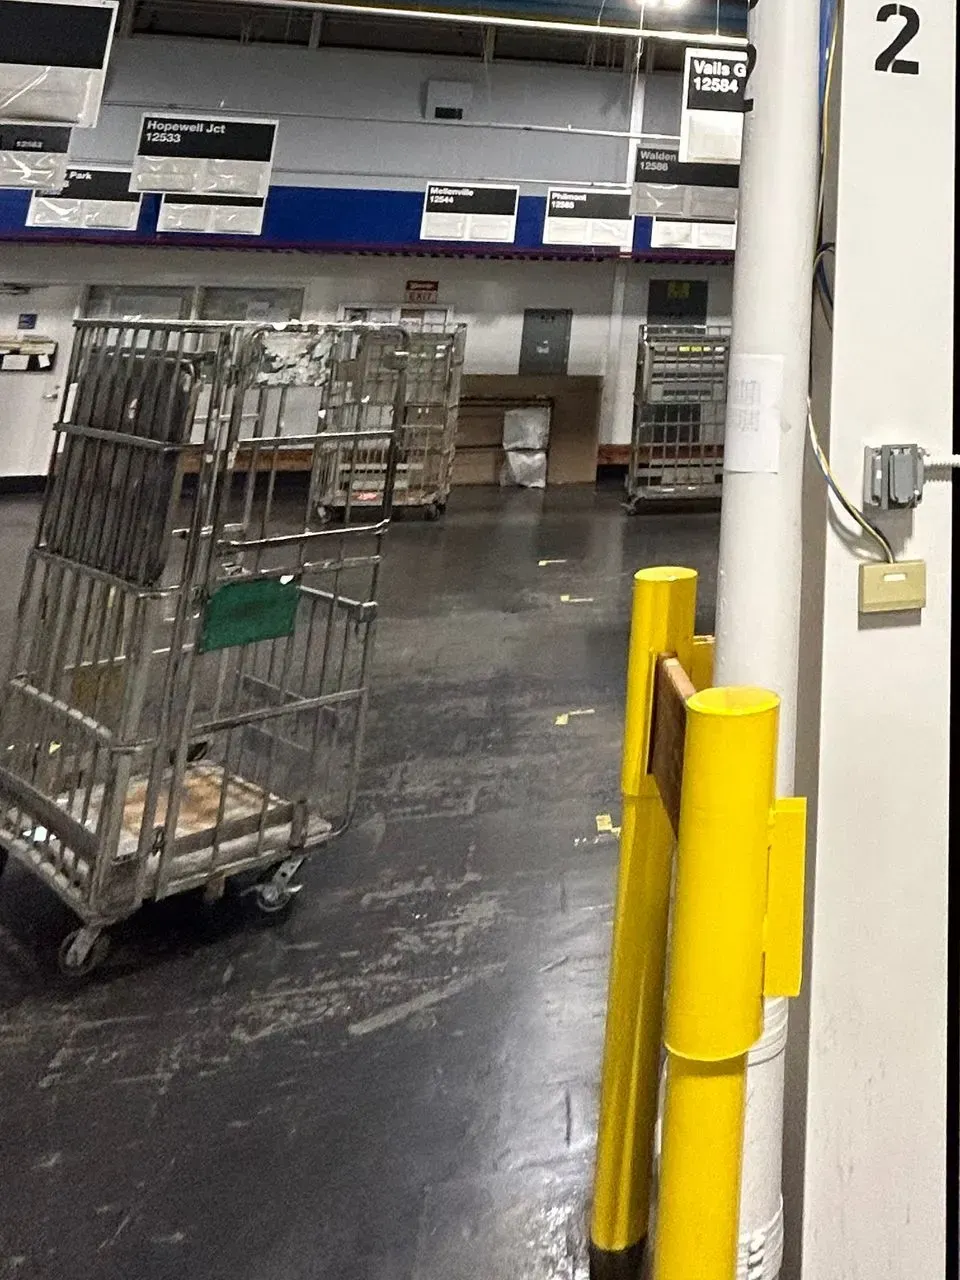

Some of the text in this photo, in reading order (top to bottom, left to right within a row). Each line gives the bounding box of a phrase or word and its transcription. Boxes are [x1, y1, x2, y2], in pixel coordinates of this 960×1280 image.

[875, 3, 920, 75] 2
[693, 60, 731, 76] Vails
[693, 77, 739, 93] 12584
[147, 120, 226, 133] Hopewell Jct
[146, 133, 181, 143] 12533
[640, 150, 677, 161] Walden
[69, 171, 92, 180] Park
